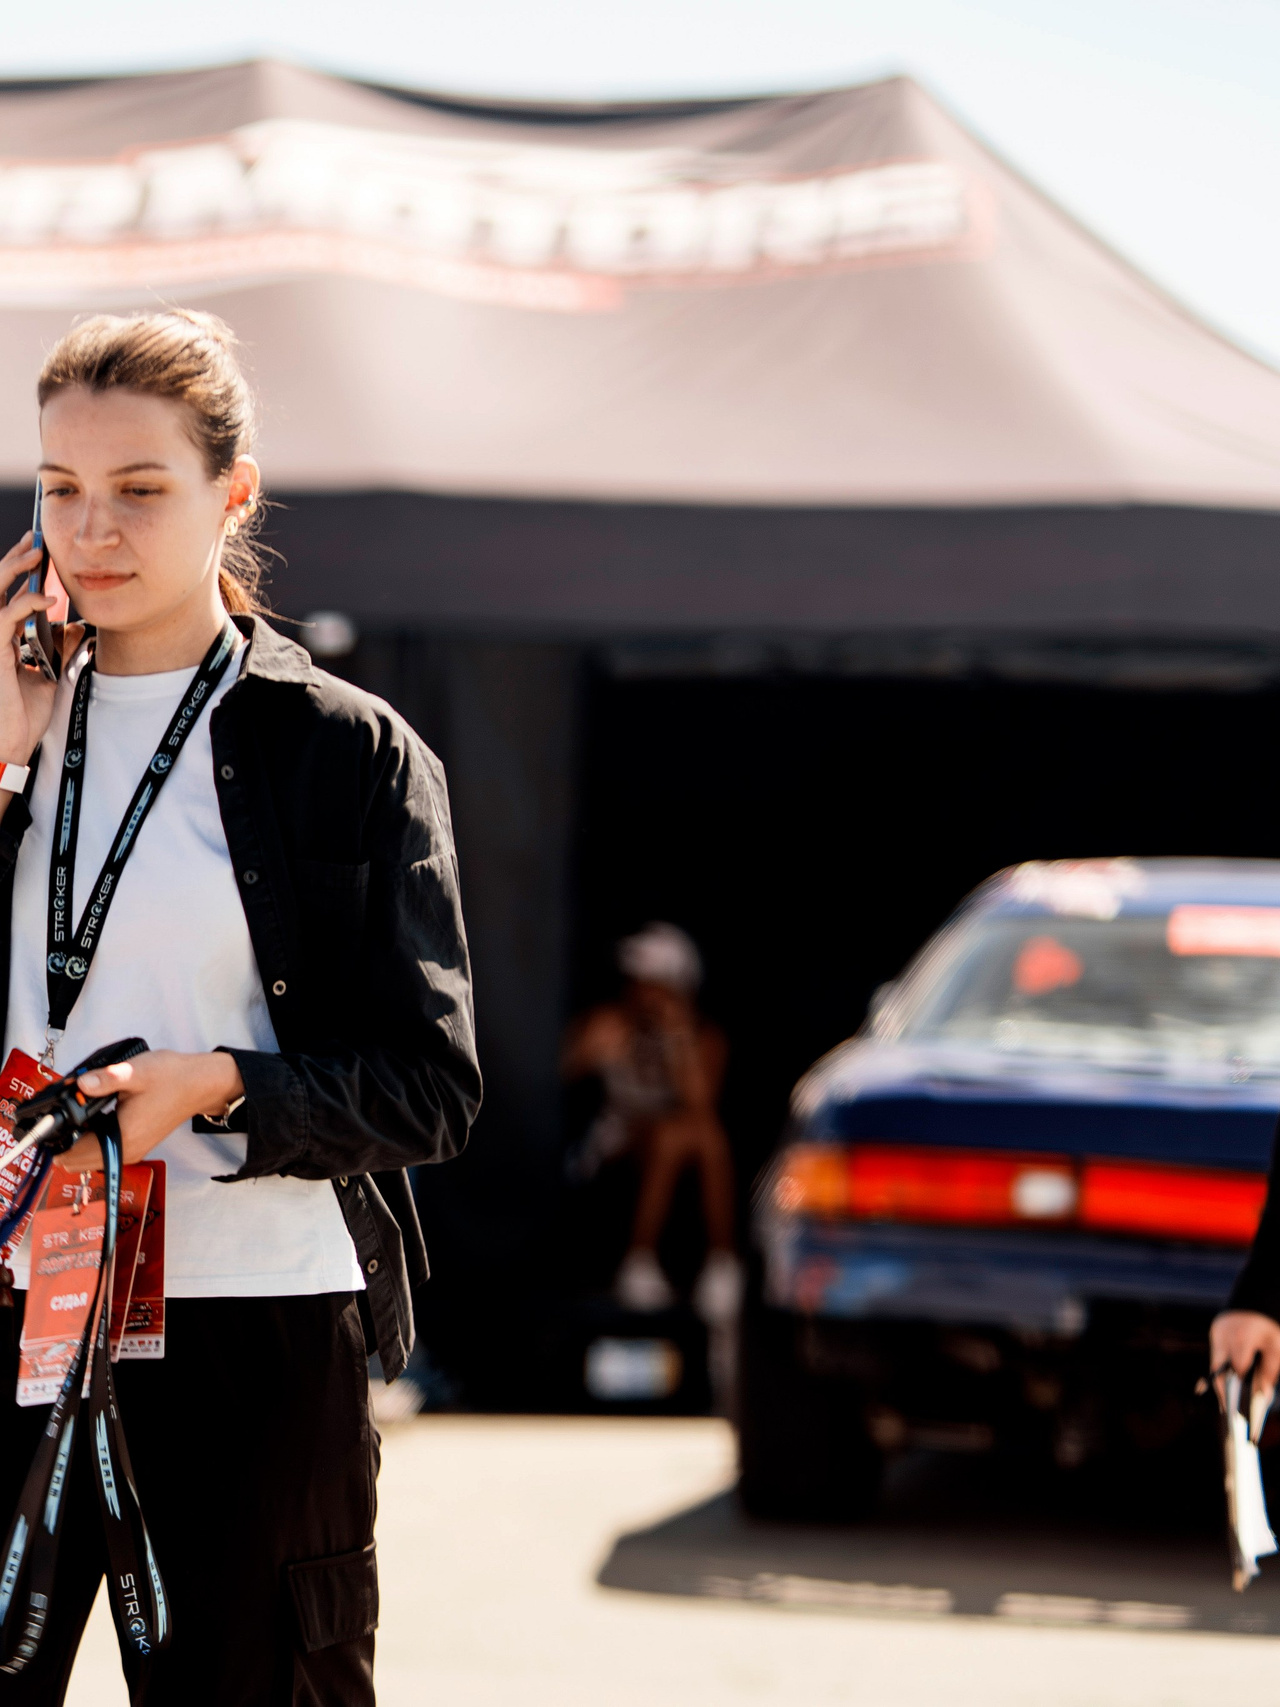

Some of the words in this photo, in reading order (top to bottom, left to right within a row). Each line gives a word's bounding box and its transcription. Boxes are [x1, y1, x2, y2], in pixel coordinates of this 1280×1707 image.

[168, 680, 209, 747] STROKER
[54, 866, 67, 942] STROKER
[80, 873, 114, 949] STROKER
